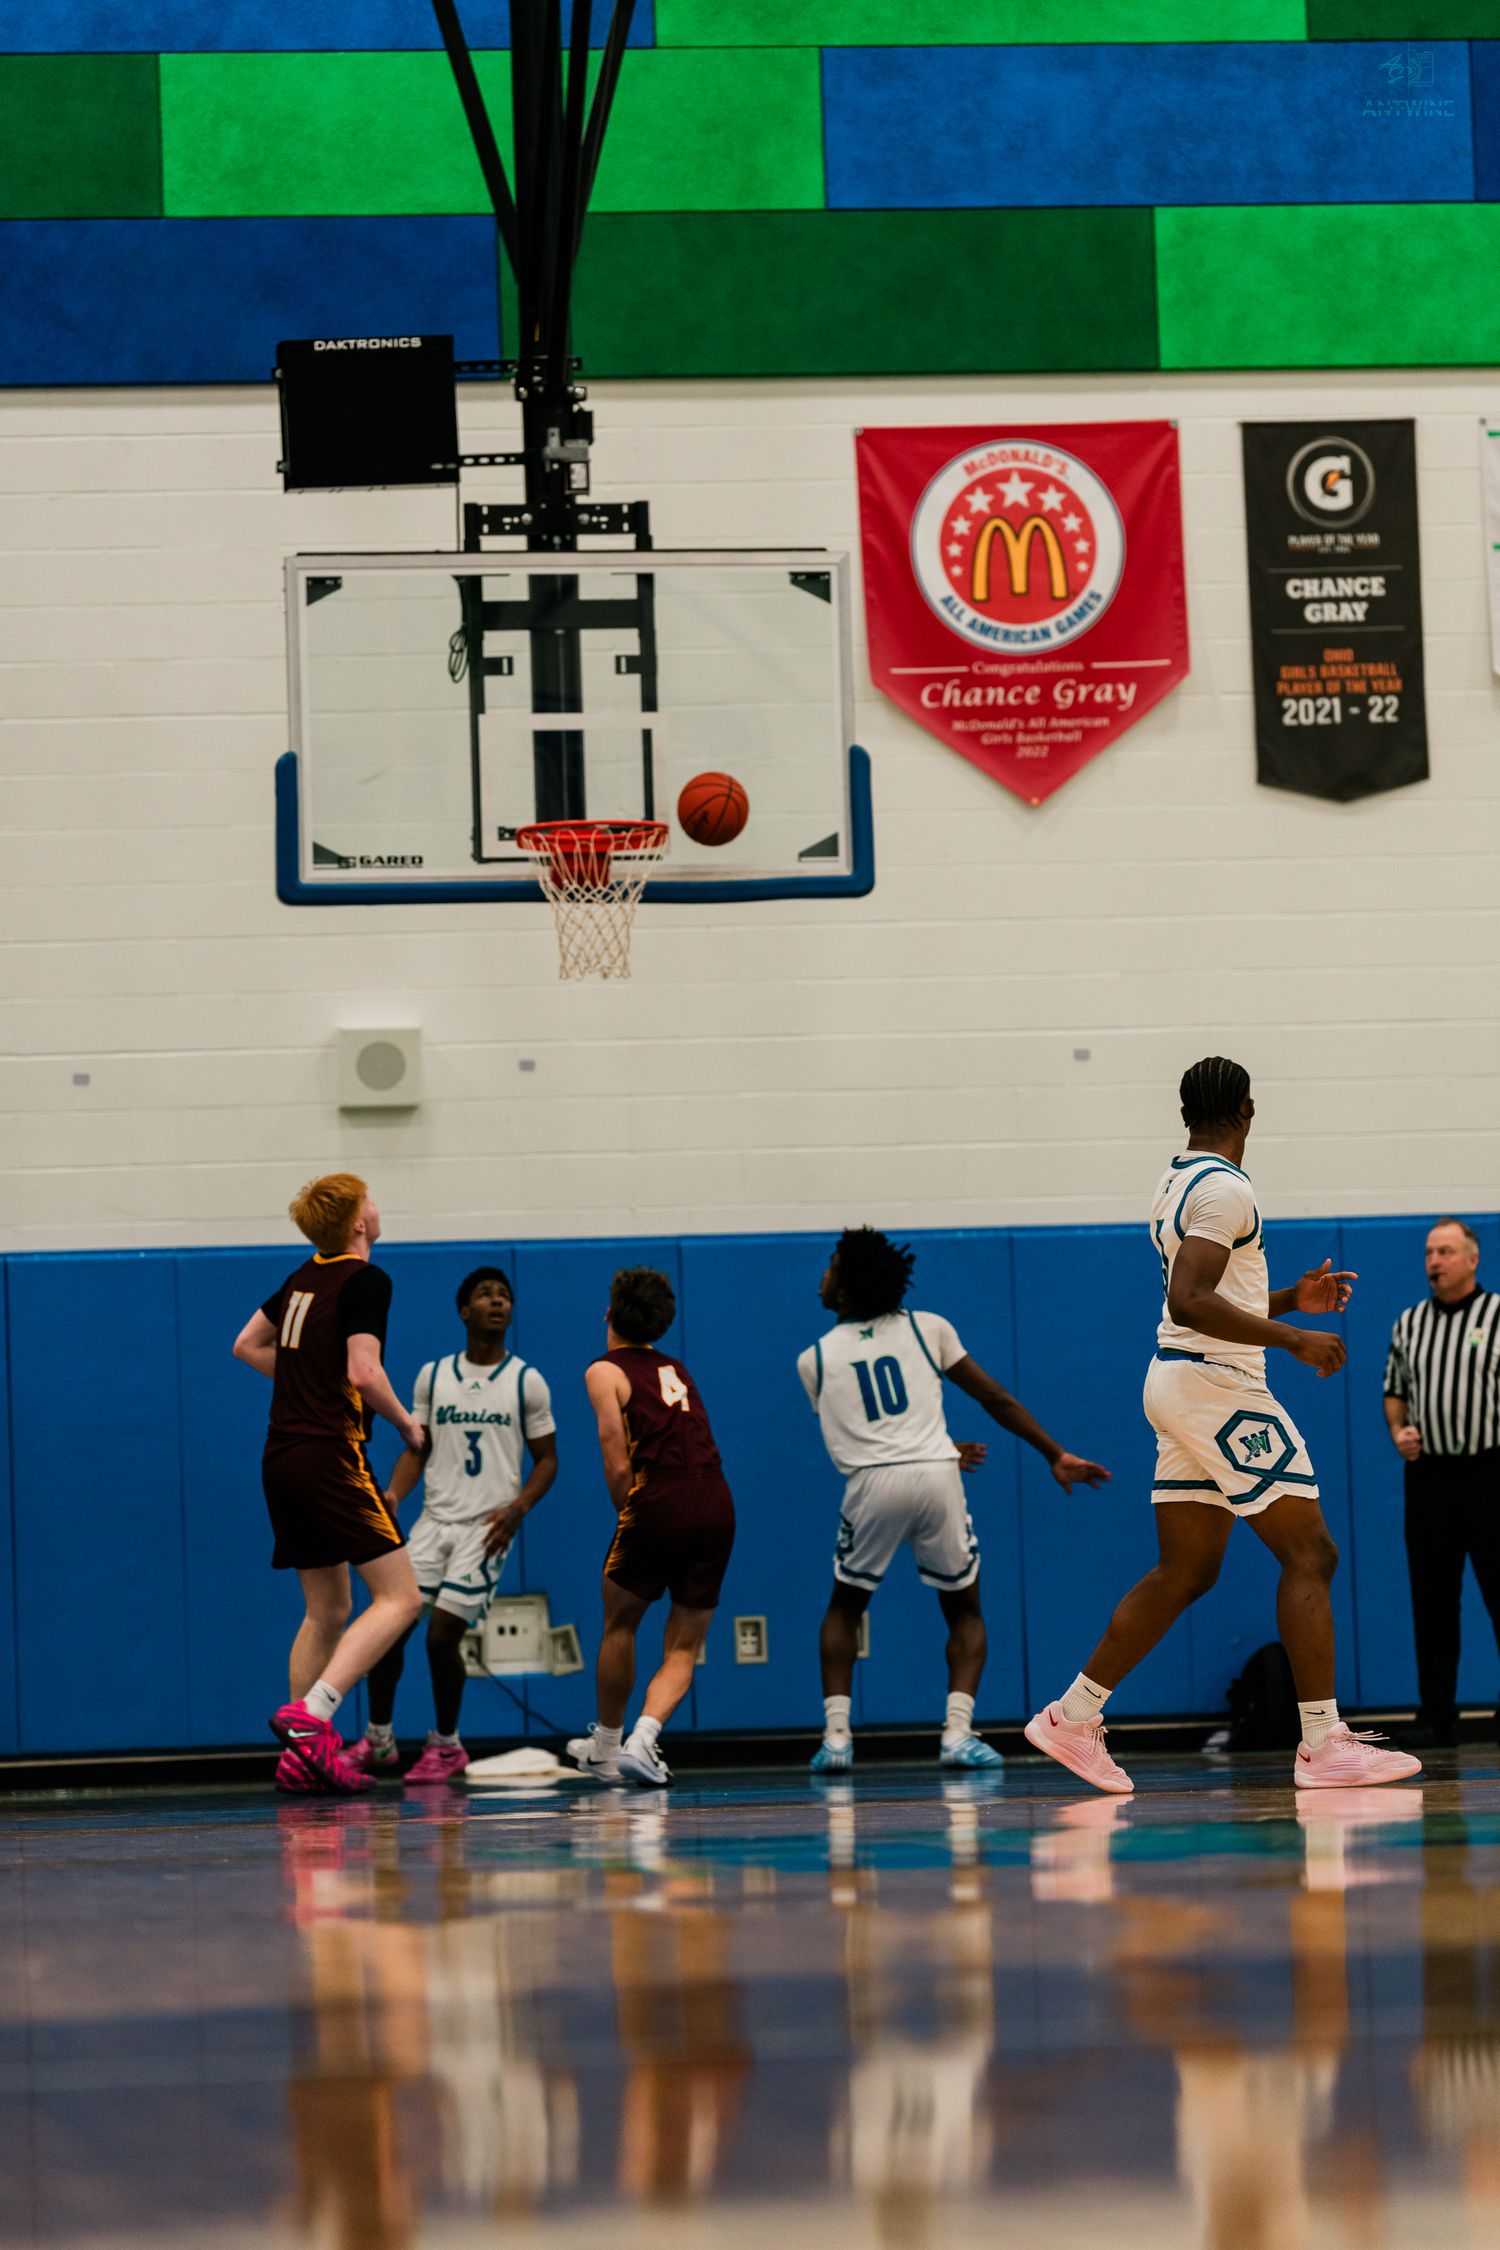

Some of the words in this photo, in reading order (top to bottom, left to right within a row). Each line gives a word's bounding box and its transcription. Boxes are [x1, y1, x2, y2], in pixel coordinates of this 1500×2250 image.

[313, 337, 422, 351] DAKTRONICS
[1286, 576, 1386, 598] CHANCE
[941, 595, 963, 621] ALL
[968, 618, 1053, 644] AMERICAN
[1055, 590, 1103, 635] GAMES
[1304, 601, 1369, 623] GRAY
[972, 660, 1084, 677] Congratulations
[1280, 665, 1317, 679] GIRLS
[1320, 662, 1397, 678] BASKETBALL
[921, 679, 1041, 709] Chance
[1053, 678, 1137, 711] Gray
[1276, 681, 1323, 696] PLAYER
[1326, 680, 1340, 694] OF
[1345, 679, 1367, 693] THE
[1371, 677, 1403, 693] YEAR
[1282, 697, 1342, 726] 2021
[1368, 695, 1399, 723] 22
[1028, 717, 1046, 729] All
[1049, 716, 1110, 729] American
[981, 732, 1012, 745] Girls
[1015, 730, 1082, 744] Basketball
[1016, 745, 1050, 758] 2022
[359, 856, 424, 868] GARED
[280, 1290, 315, 1349] 11
[657, 1365, 690, 1412] 4
[849, 1355, 909, 1423] 10
[436, 1404, 512, 1427] Warriors
[464, 1431, 482, 1477] 3
